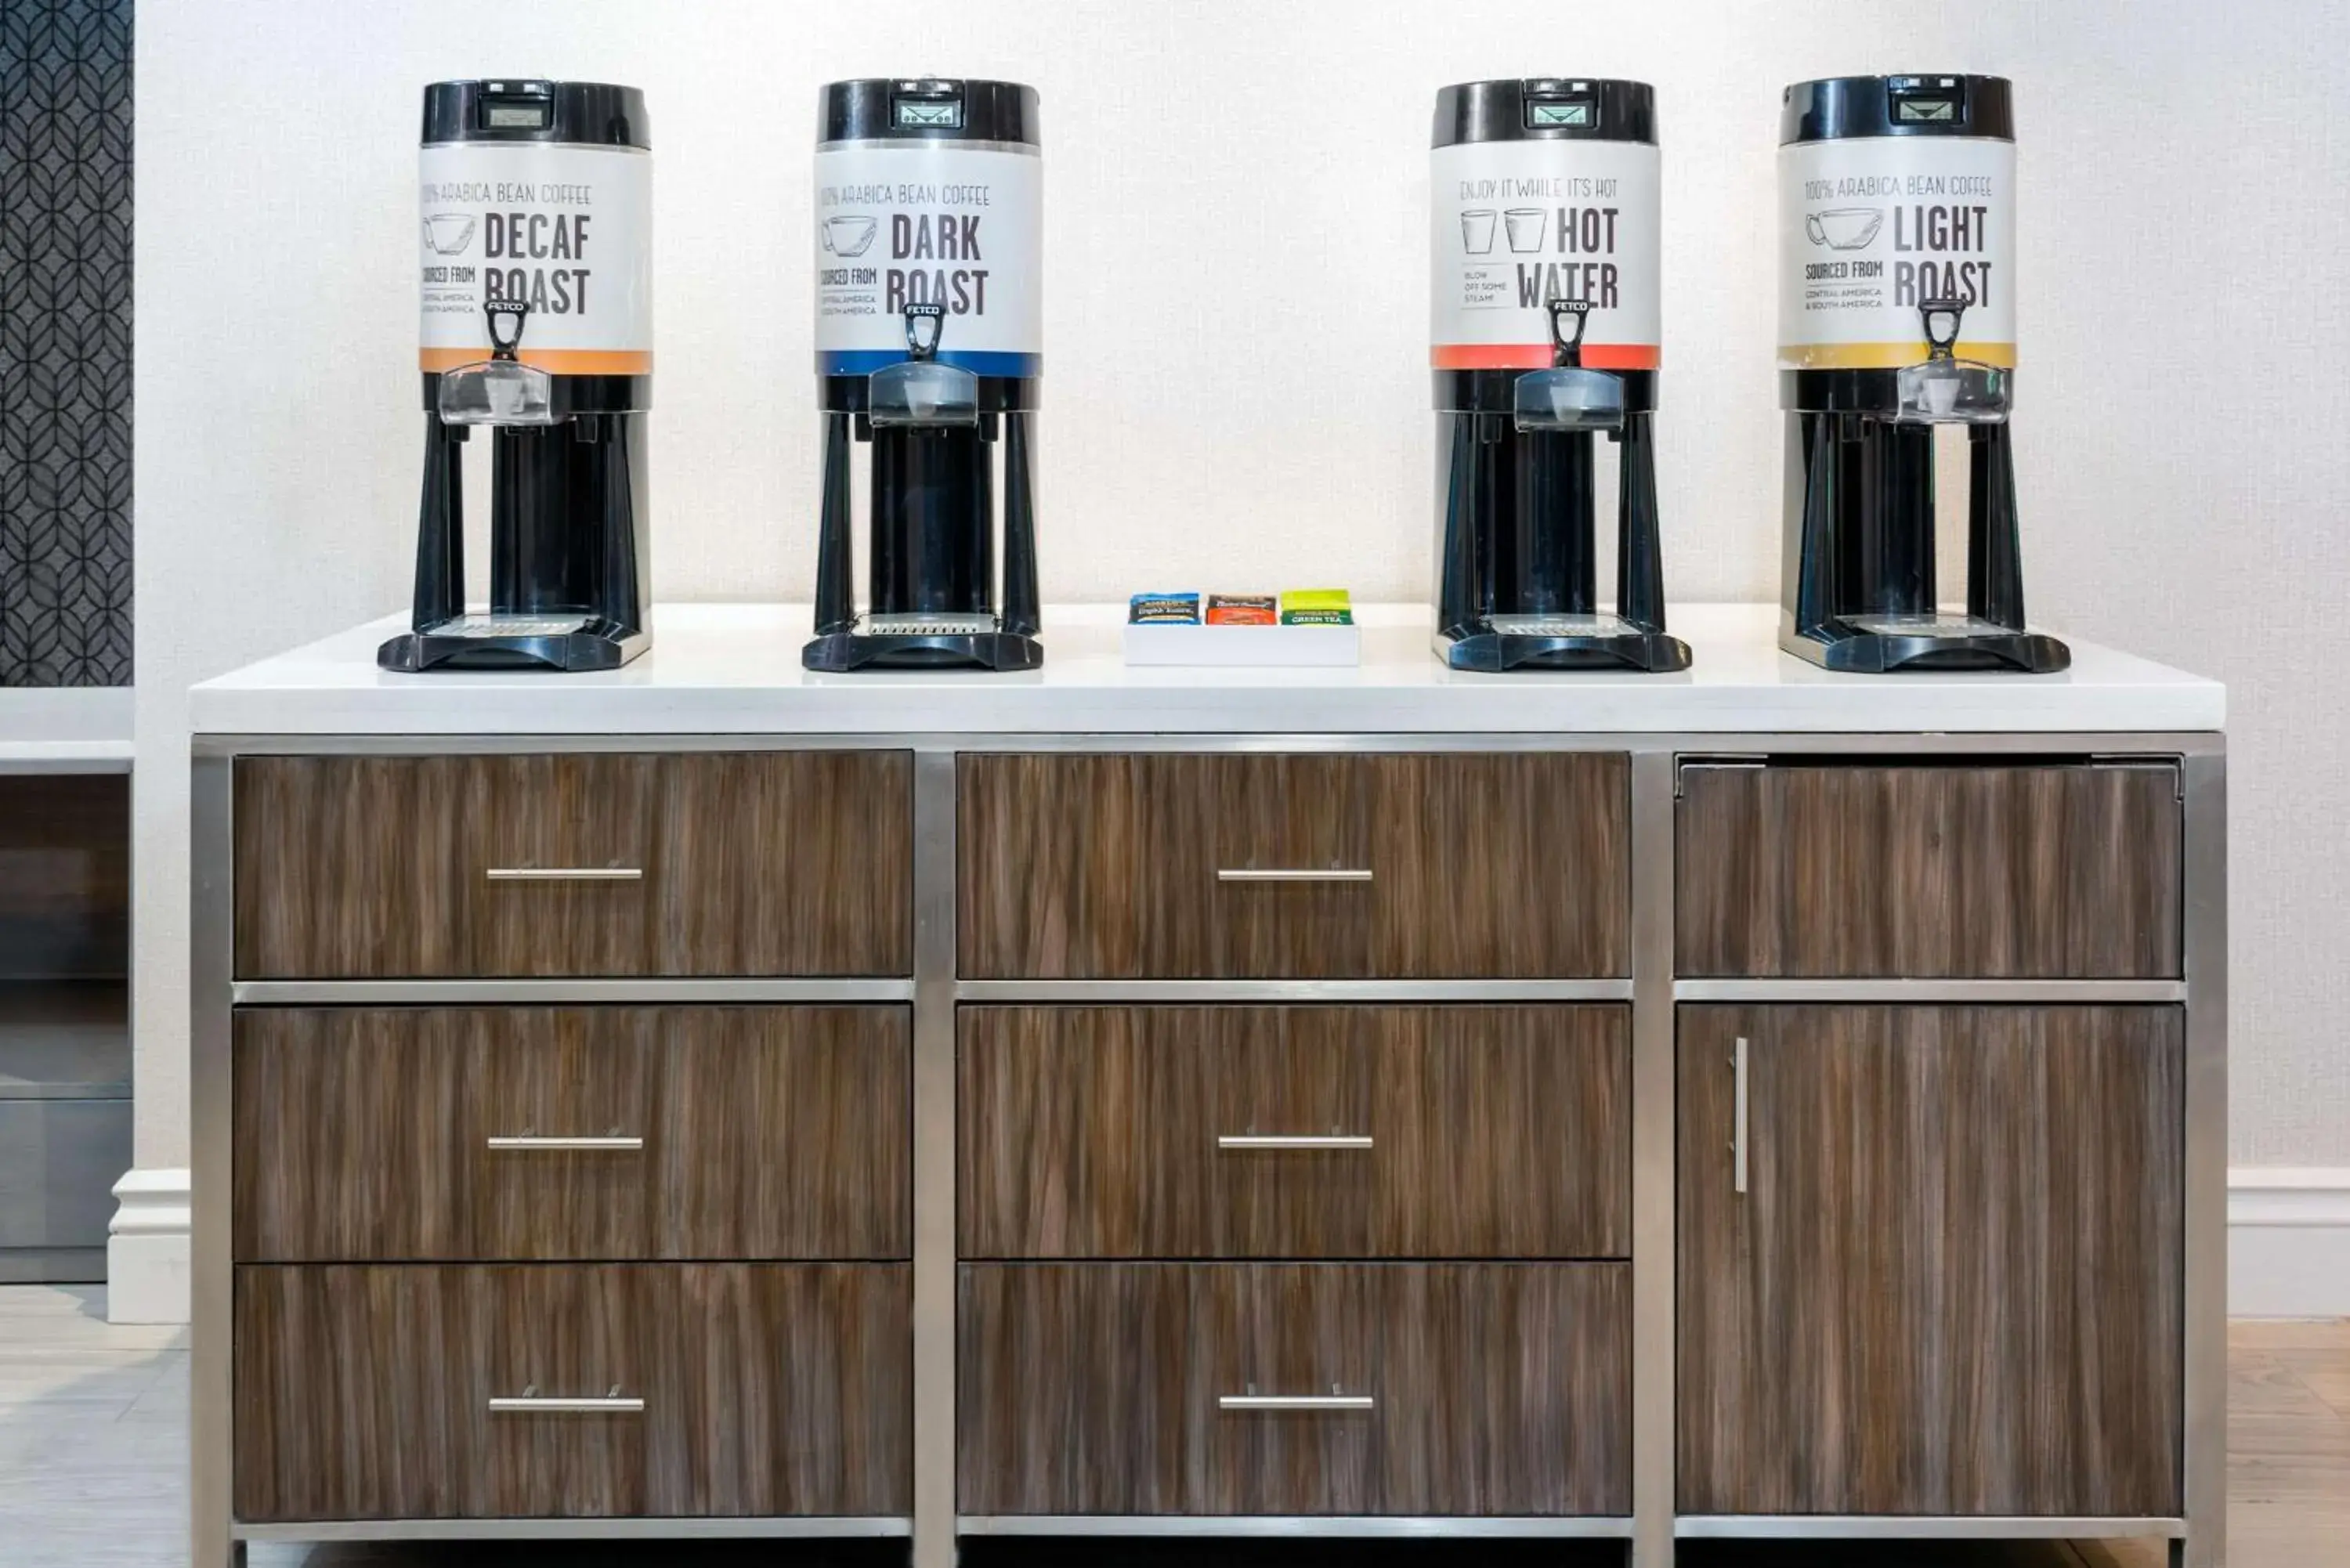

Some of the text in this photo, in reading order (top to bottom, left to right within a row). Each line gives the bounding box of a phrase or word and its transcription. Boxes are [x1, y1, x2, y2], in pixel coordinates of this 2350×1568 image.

[440, 182, 491, 203] ARABICA
[497, 182, 535, 203] BEAN
[541, 185, 592, 205] COFFEE
[841, 185, 893, 205] ARABICA
[899, 184, 937, 204] BEAN
[942, 186, 990, 206] COFFEE
[1460, 178, 1617, 201] ENJOY IT WHILE IT'S HOT
[1806, 175, 1992, 200] 100% ARABICA BEAN COFFEE
[485, 212, 591, 259] DECAF
[891, 214, 982, 261] DARK
[1557, 208, 1618, 254] HOT
[1894, 205, 1987, 252] LIGHT
[450, 266, 475, 283] FROM
[851, 267, 877, 284] FROM
[1806, 261, 1883, 280] SOURCED FROM
[485, 267, 591, 315] ROAST
[887, 269, 989, 316] ROAST
[1517, 262, 1618, 309] WATER
[1841, 288, 1882, 298] AMERICA
[1894, 261, 1992, 308] ROAST
[1554, 302, 1588, 311] FETCO
